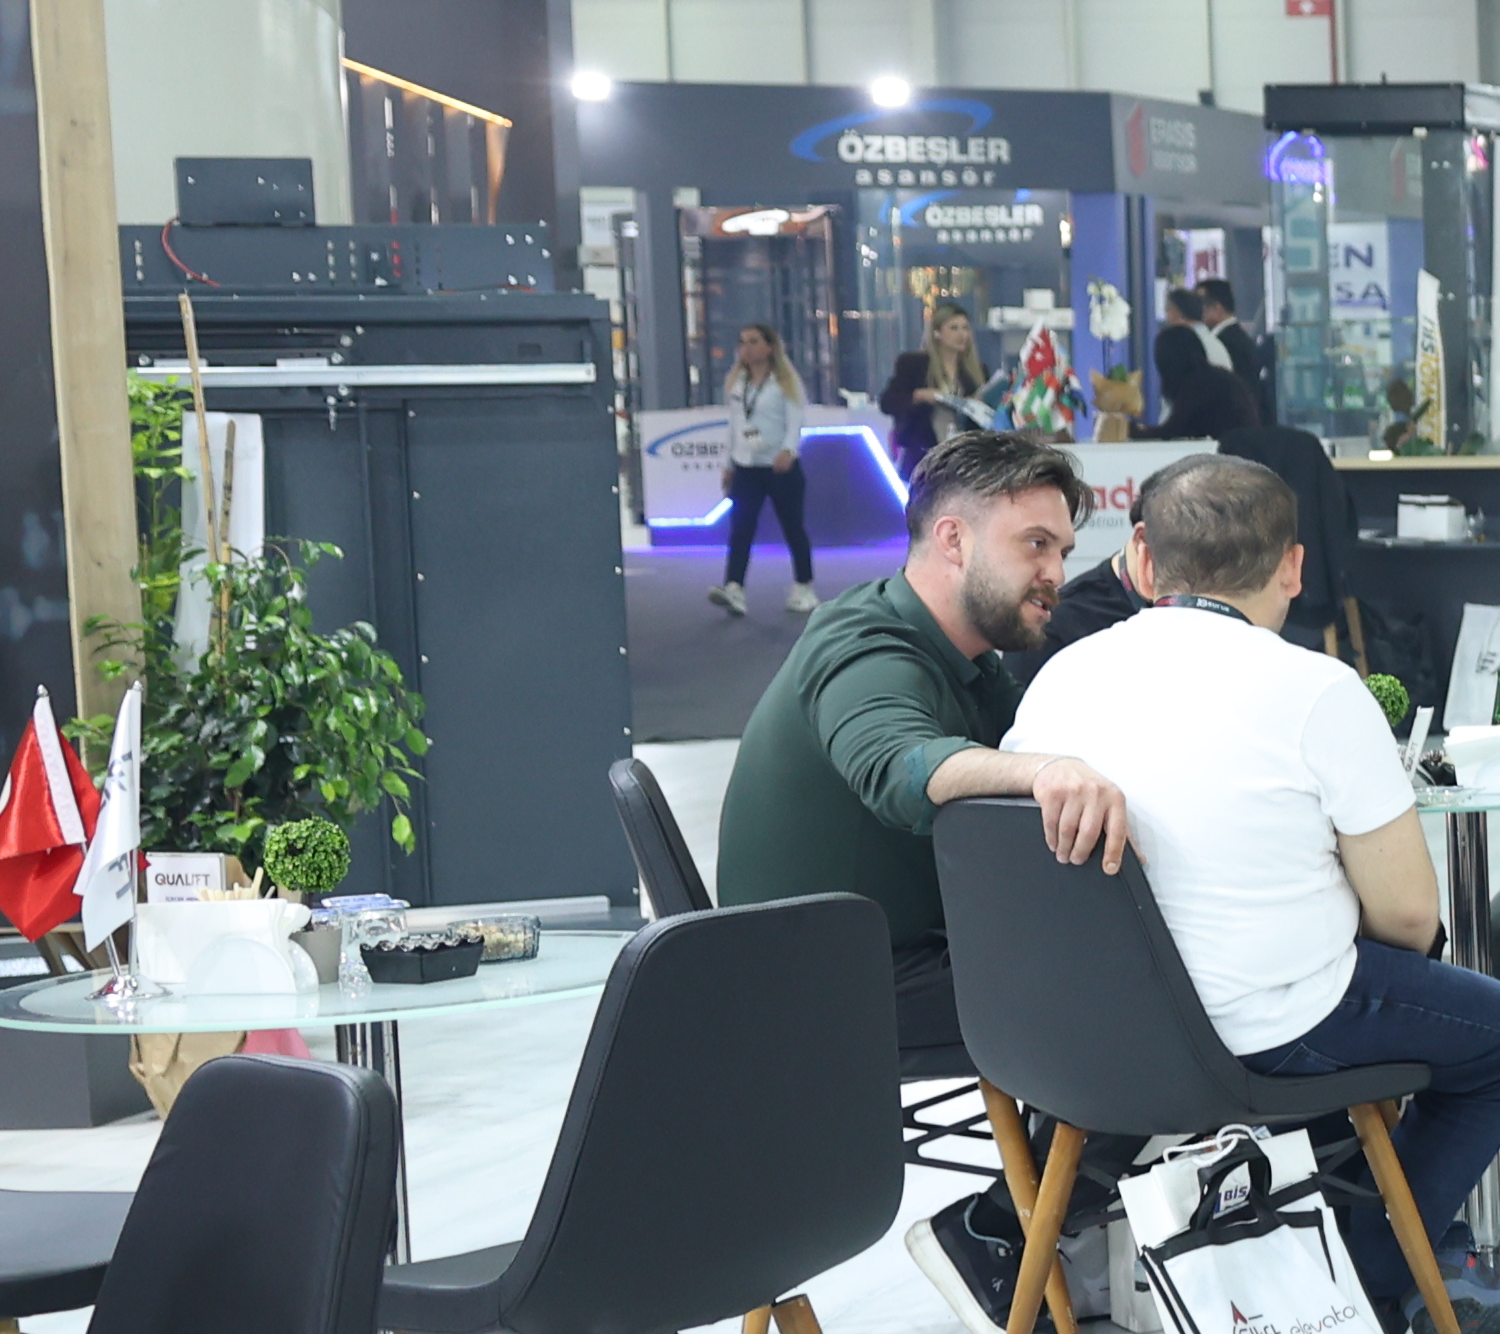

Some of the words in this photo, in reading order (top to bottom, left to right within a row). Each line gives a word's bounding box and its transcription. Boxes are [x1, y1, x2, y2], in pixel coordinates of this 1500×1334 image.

[837, 129, 1011, 167] ÖZBEŞLER
[855, 166, 995, 186] asansör
[155, 873, 210, 886] QUALIFT
